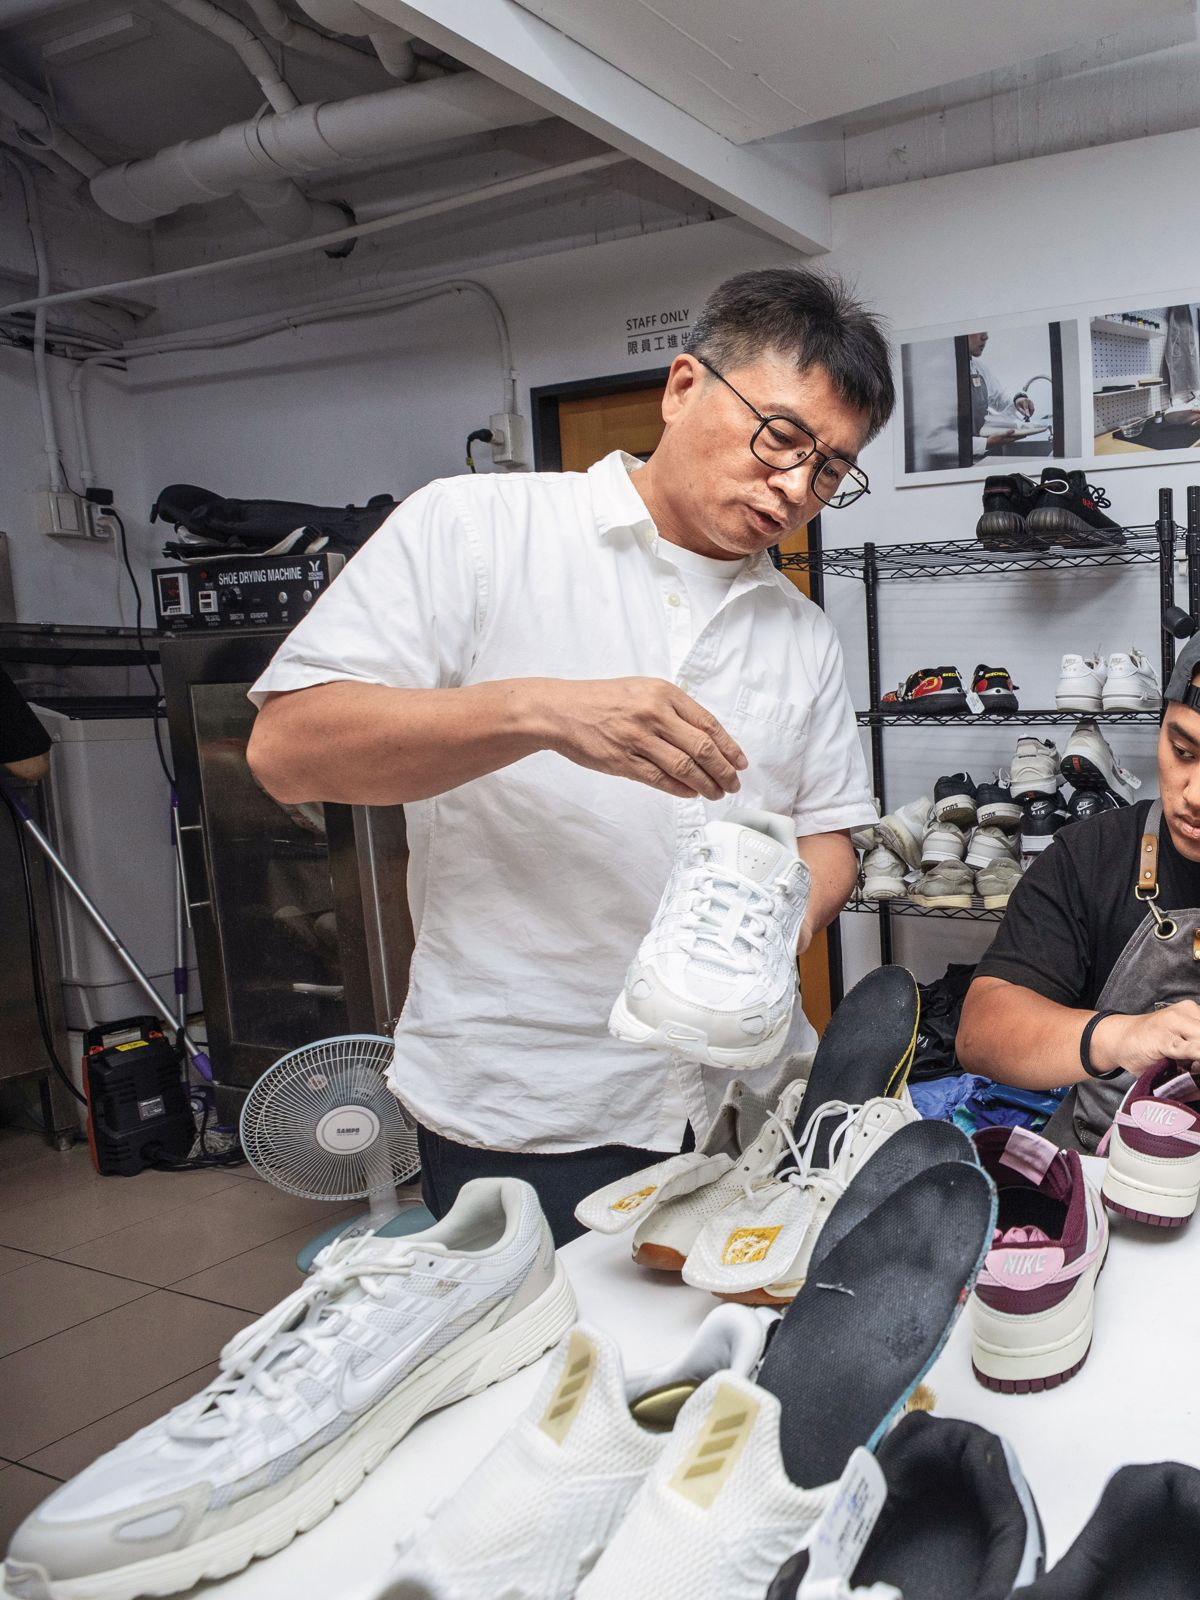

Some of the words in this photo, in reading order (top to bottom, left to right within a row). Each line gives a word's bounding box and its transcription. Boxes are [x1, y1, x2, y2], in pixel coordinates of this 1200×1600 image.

[626, 314, 657, 331] STAFF
[660, 309, 690, 325] ONLY
[218, 570, 239, 585] SHOE
[239, 569, 266, 584] DRYING
[267, 566, 302, 581] MACHINE
[745, 838, 775, 855] NIKE
[1143, 1104, 1178, 1127] NIKE
[1004, 1254, 1047, 1275] NIKE
